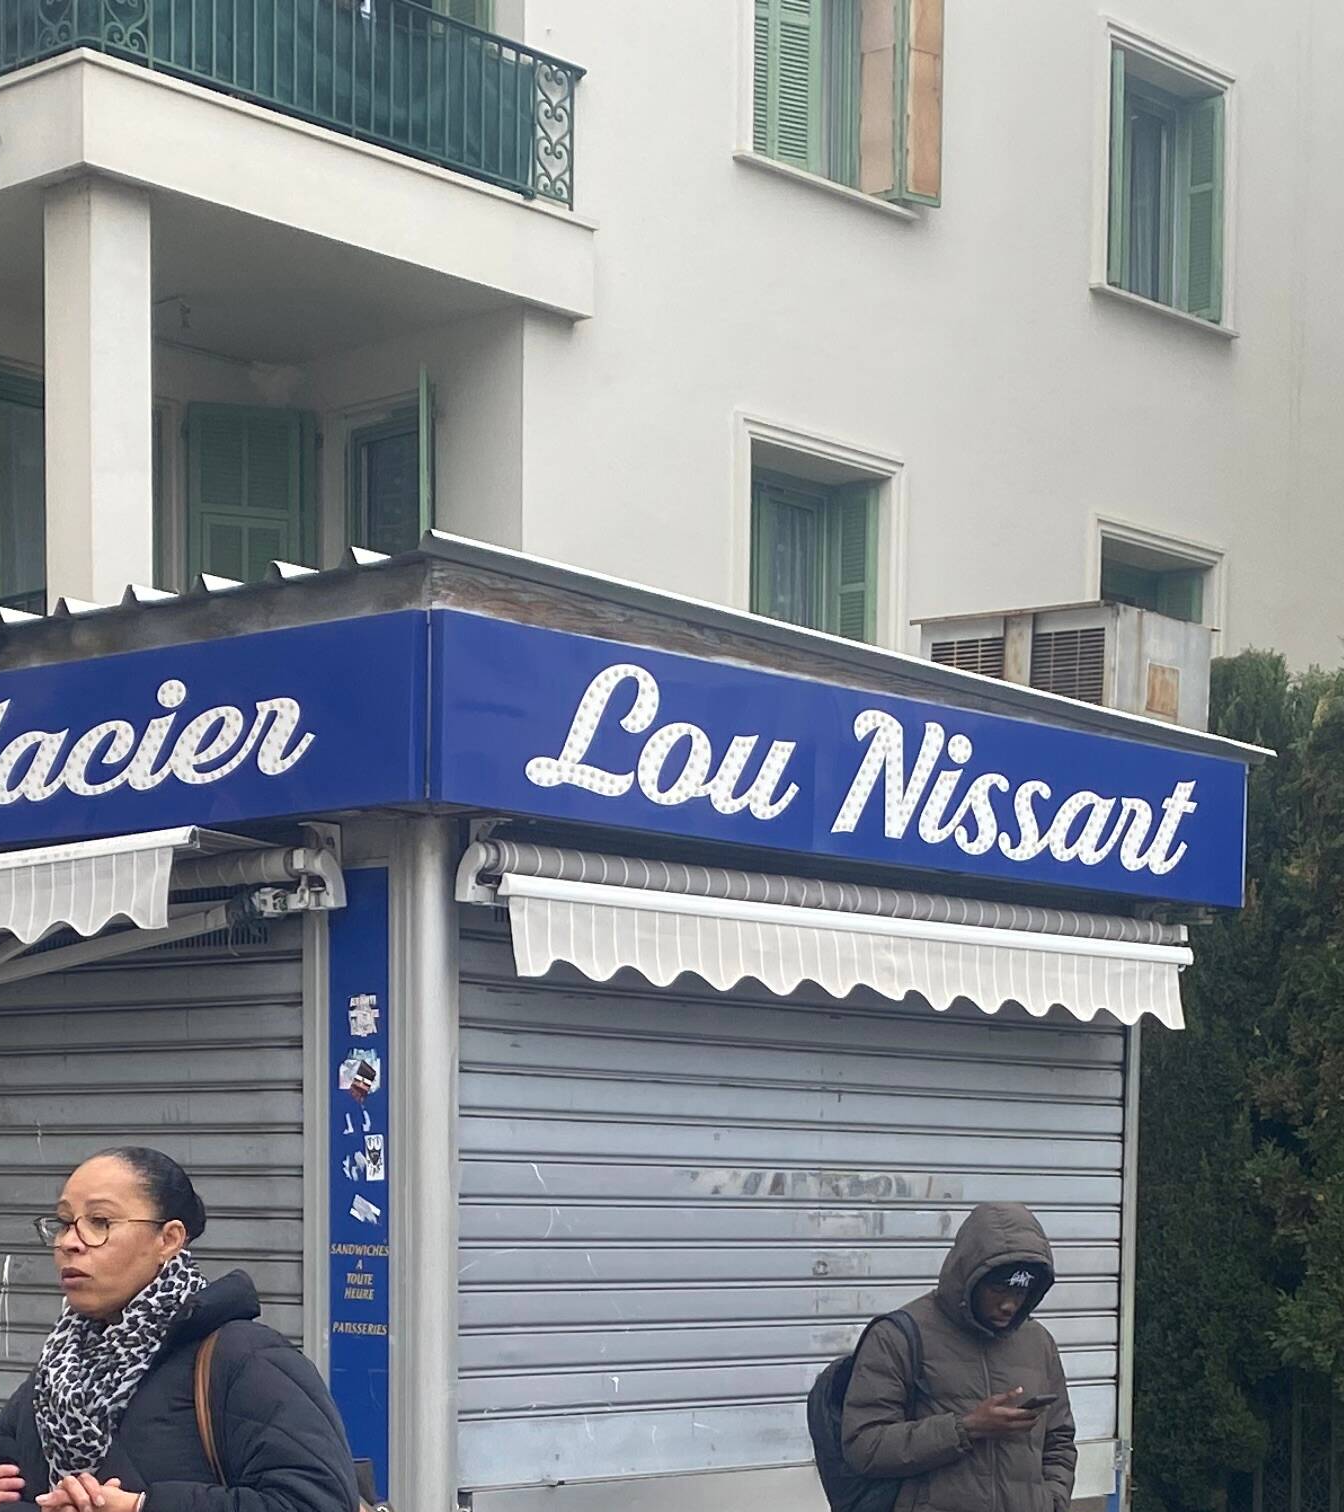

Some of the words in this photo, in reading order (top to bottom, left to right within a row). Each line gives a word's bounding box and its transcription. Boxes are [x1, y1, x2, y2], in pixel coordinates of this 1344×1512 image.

[525, 663, 799, 821] Lou
[831, 709, 1199, 876] Nissart
[330, 1243, 390, 1257] SANDWICHES
[356, 1259, 363, 1270] A
[346, 1272, 374, 1286] TOUTE
[344, 1287, 375, 1300] HEURE
[332, 1321, 388, 1336] PATISSERIES
